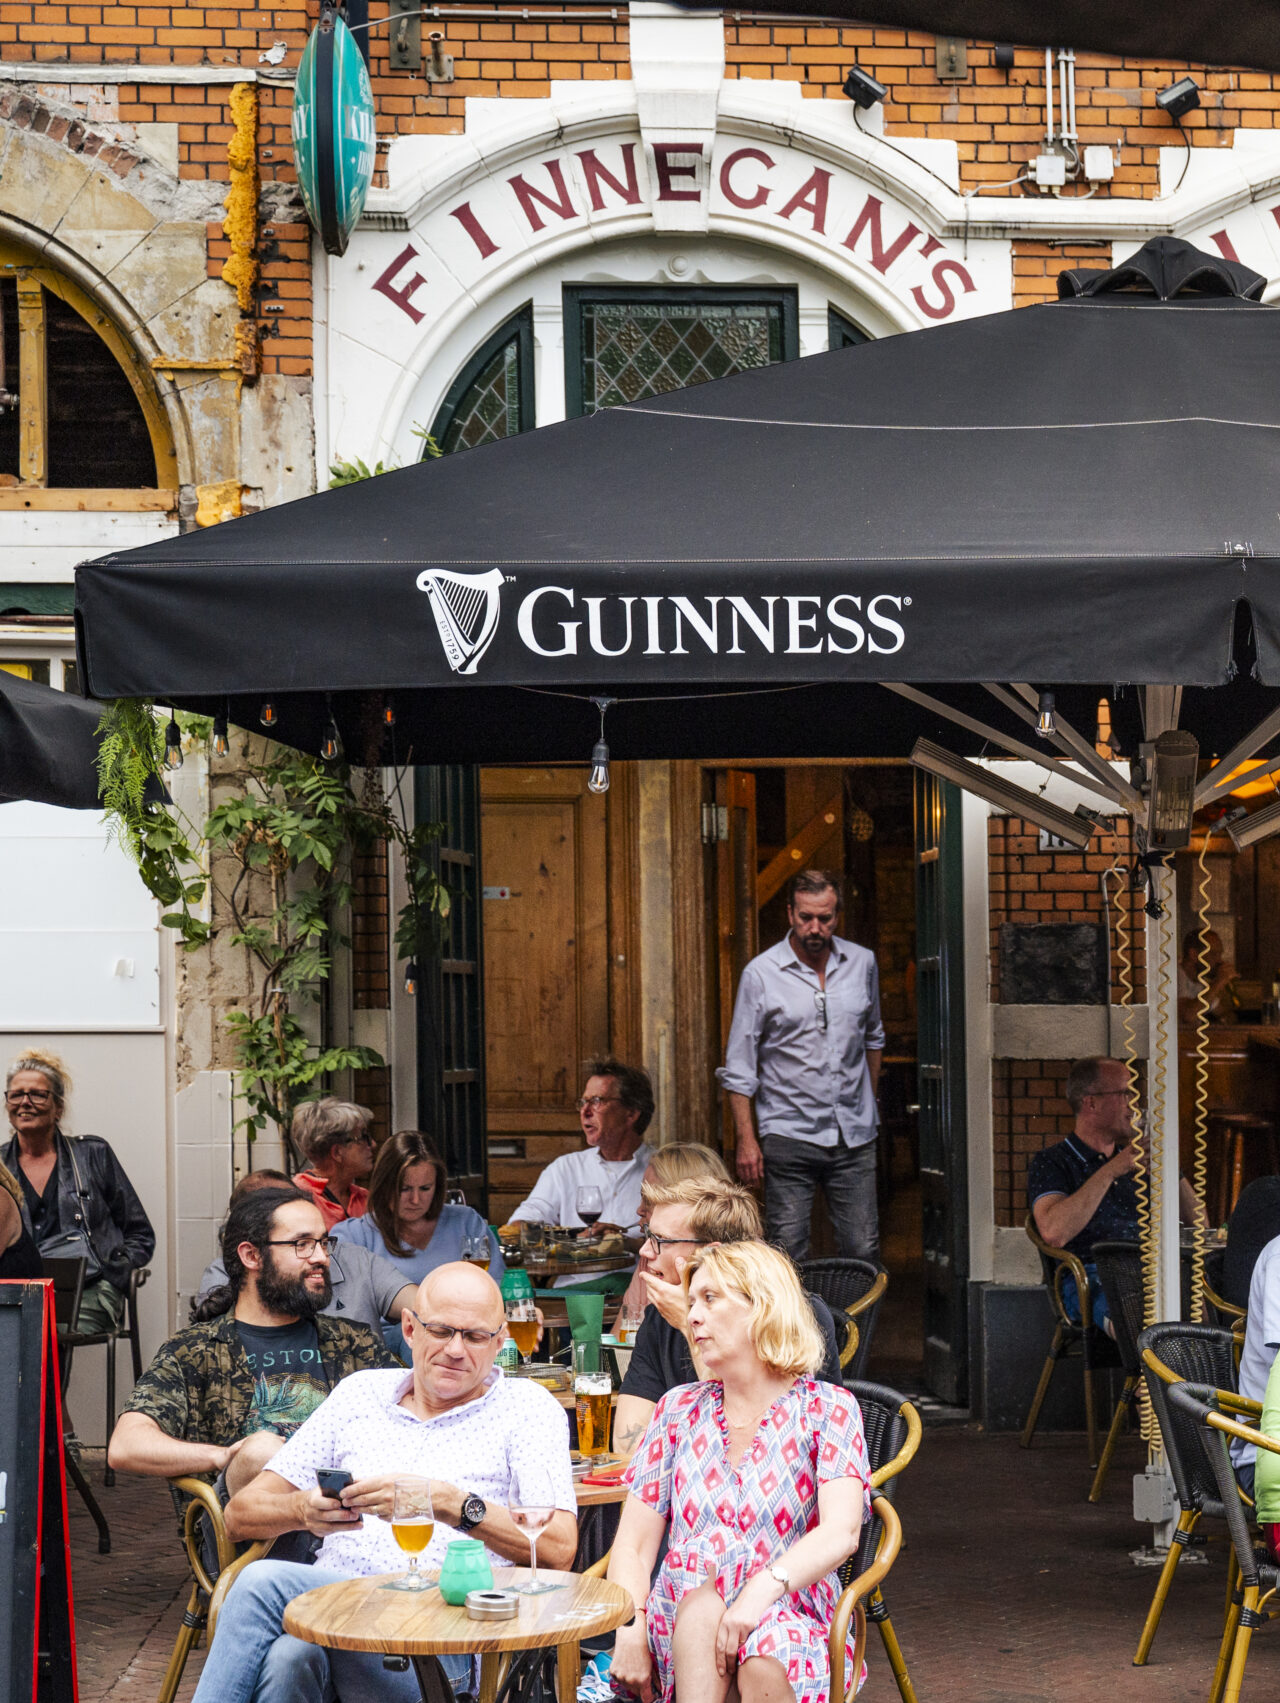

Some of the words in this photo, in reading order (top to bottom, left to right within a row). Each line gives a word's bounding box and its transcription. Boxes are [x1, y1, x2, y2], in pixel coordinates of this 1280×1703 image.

[371, 142, 978, 325] FINNEGAN'S
[445, 638, 460, 661] 1759
[516, 585, 906, 657] GUINNESS
